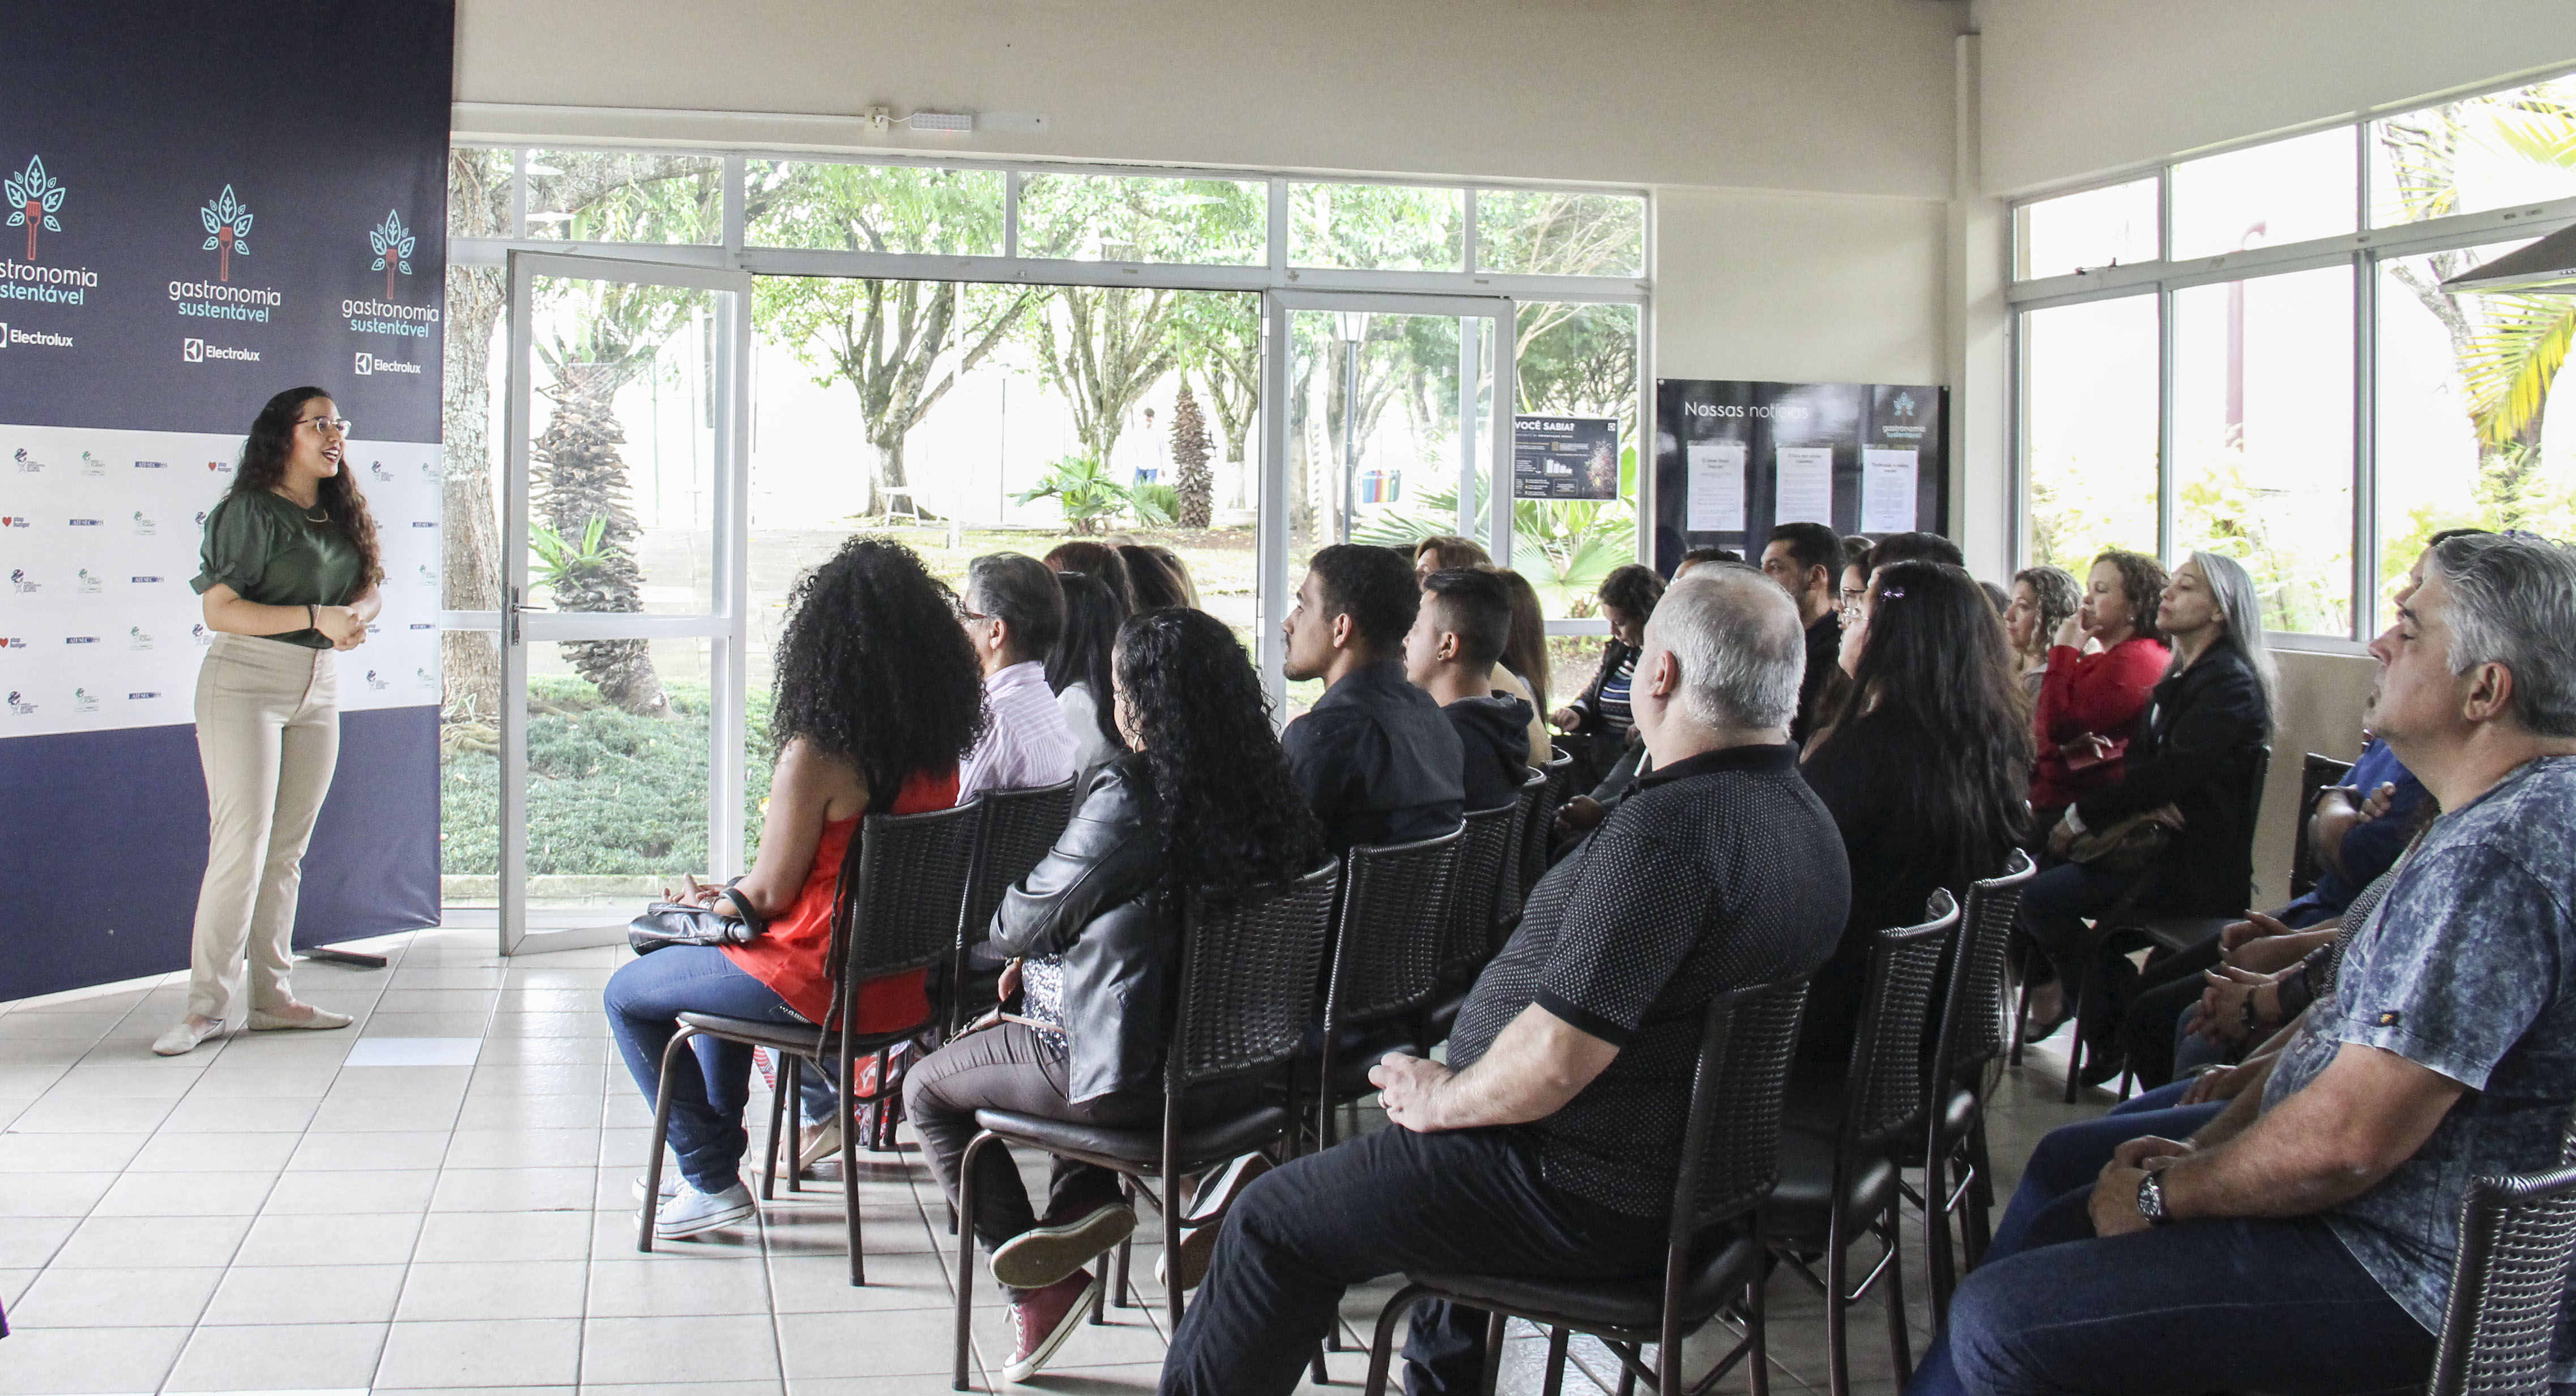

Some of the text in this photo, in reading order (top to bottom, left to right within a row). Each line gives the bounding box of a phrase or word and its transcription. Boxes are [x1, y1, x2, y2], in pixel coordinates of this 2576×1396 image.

[169, 280, 281, 306] gastronomia
[178, 301, 269, 322] sustentável
[342, 298, 440, 322] gastronomia
[350, 318, 429, 338] sustentável
[10, 329, 73, 347] Electrolux
[206, 345, 260, 361] Electrolux
[374, 358, 421, 374] Electrolux
[1684, 401, 1745, 417] Nossas
[1515, 420, 1575, 432] VOCÊ SABIA?
